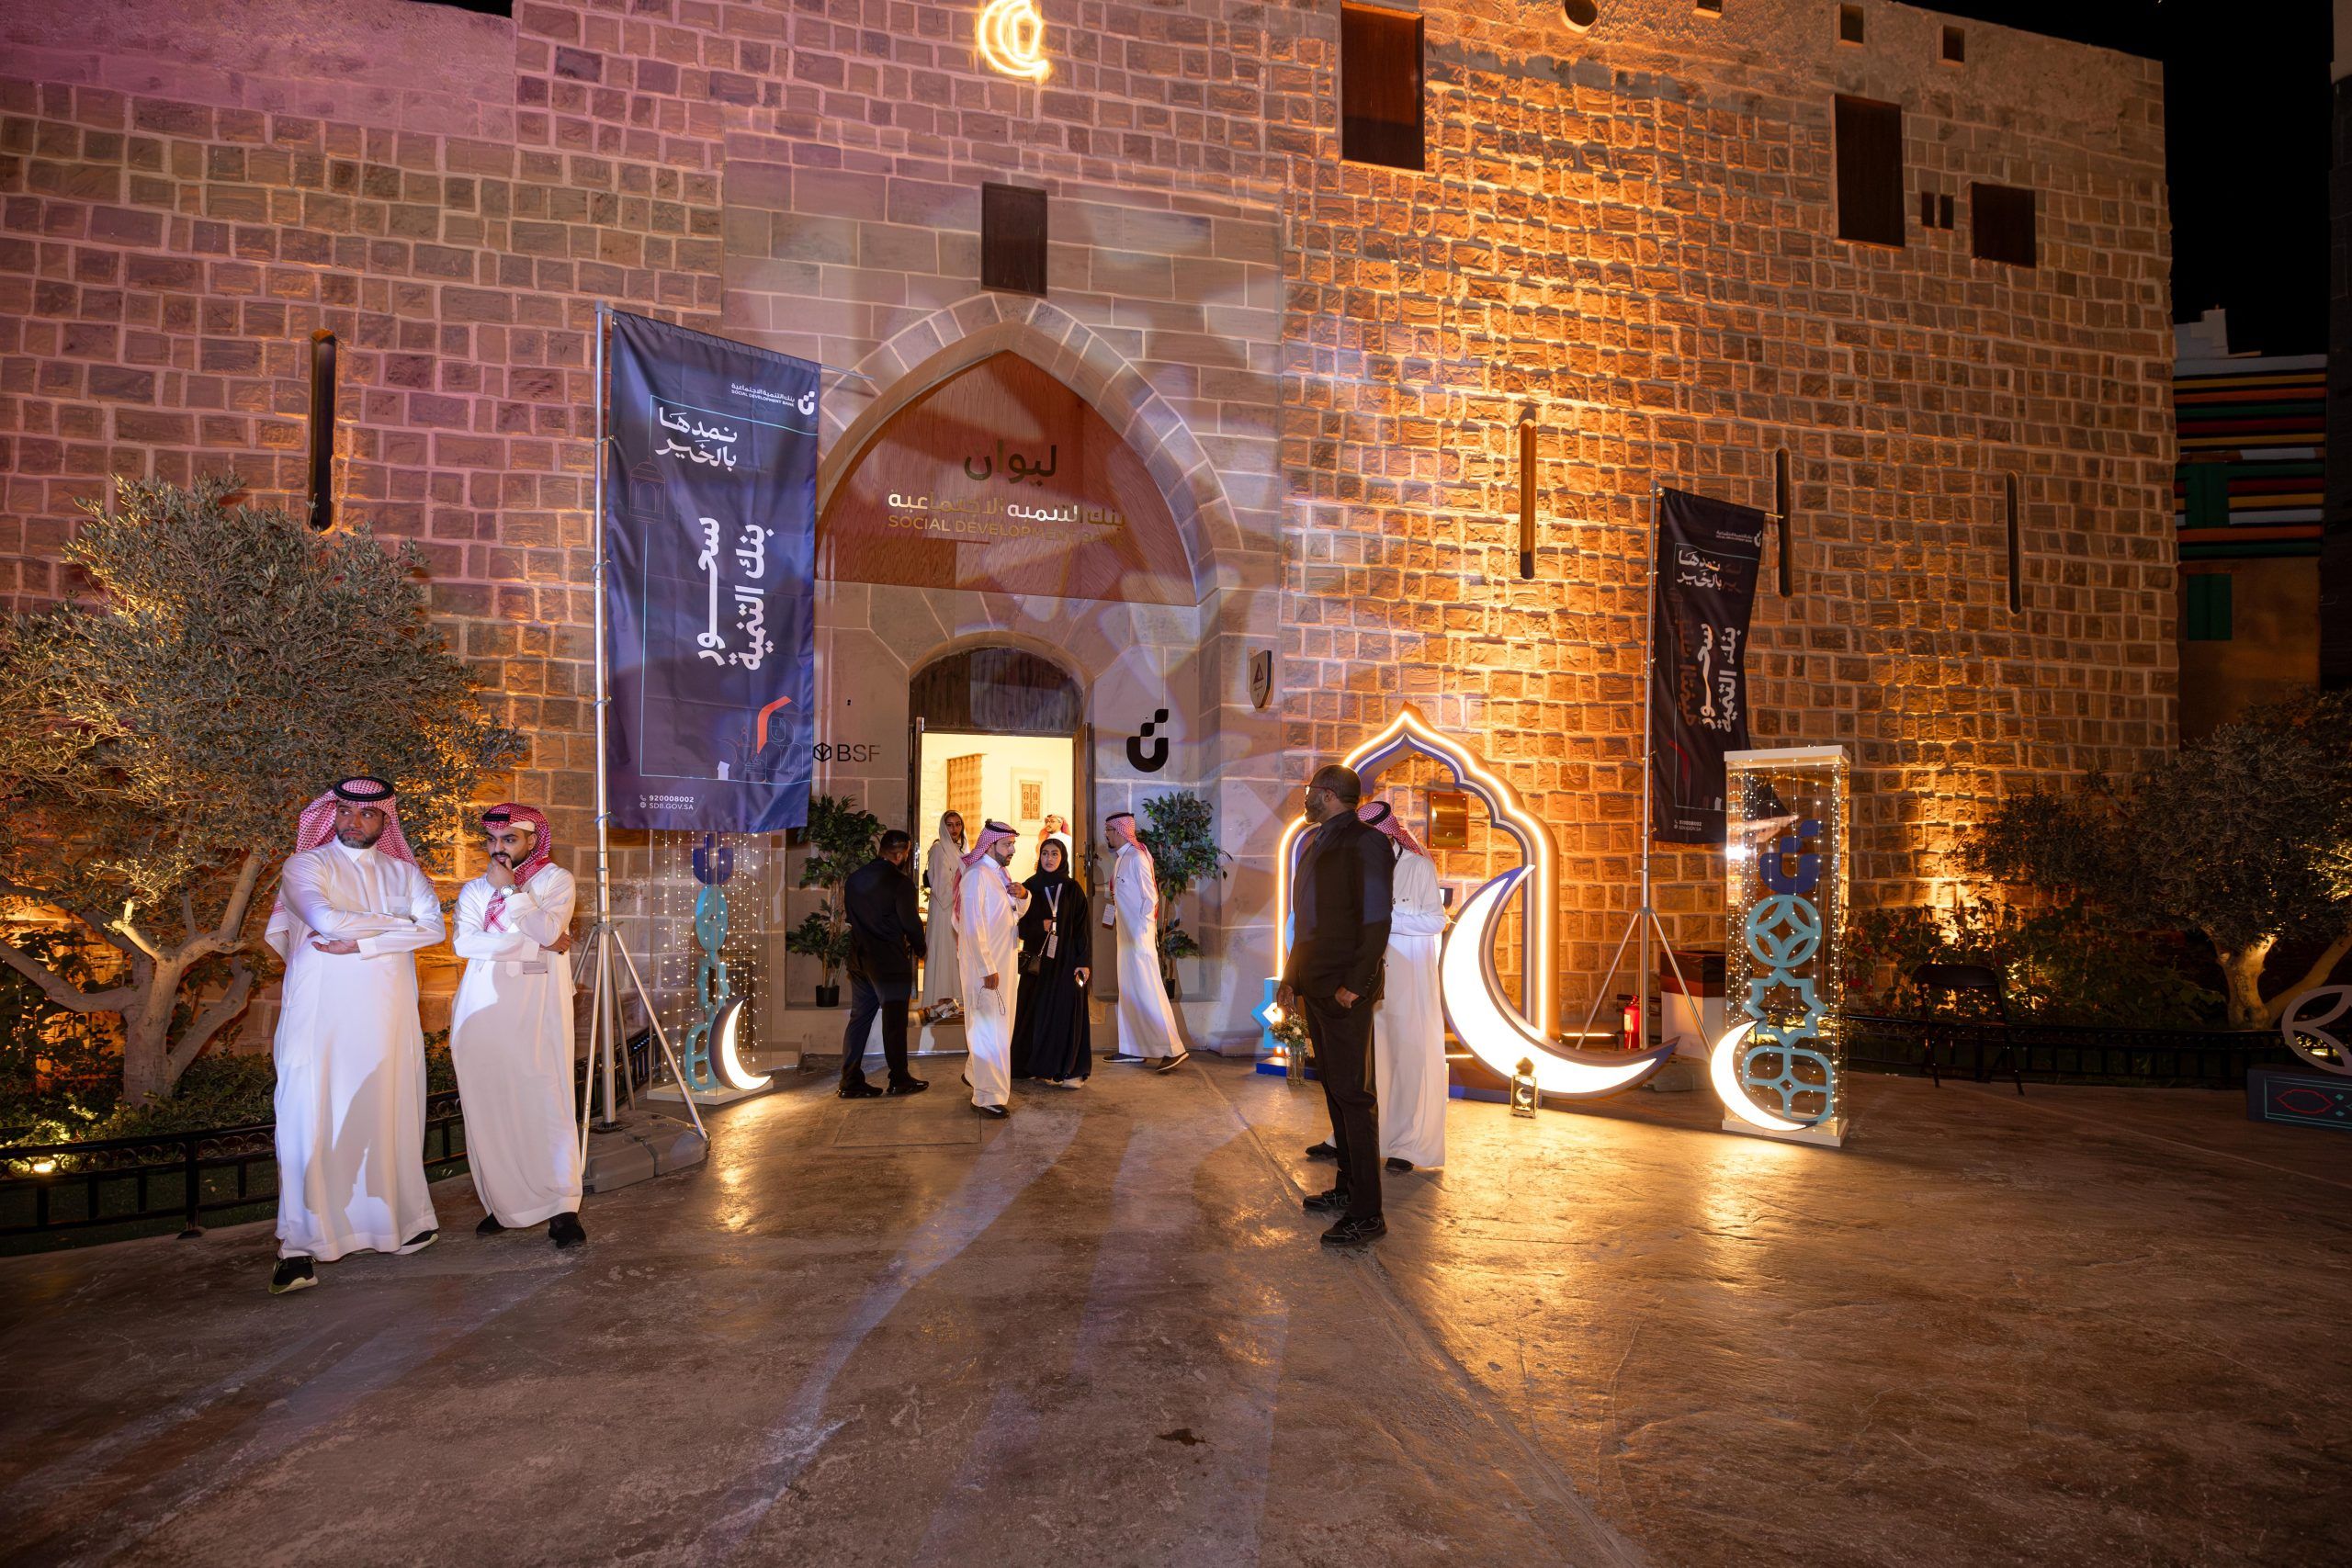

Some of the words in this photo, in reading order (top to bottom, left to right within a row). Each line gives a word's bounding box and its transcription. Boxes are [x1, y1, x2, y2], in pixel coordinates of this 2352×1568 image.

[748, 393, 782, 404] DEVELOPMENT
[782, 400, 795, 408] BANK
[1087, 507, 1125, 532] بنك
[888, 514, 951, 533] SOCIAL
[955, 519, 1075, 543] DEVELOPMENT
[837, 743, 881, 763] BSF
[649, 795, 695, 803] 920008002
[649, 802, 695, 810] SDB.GOV.SA
